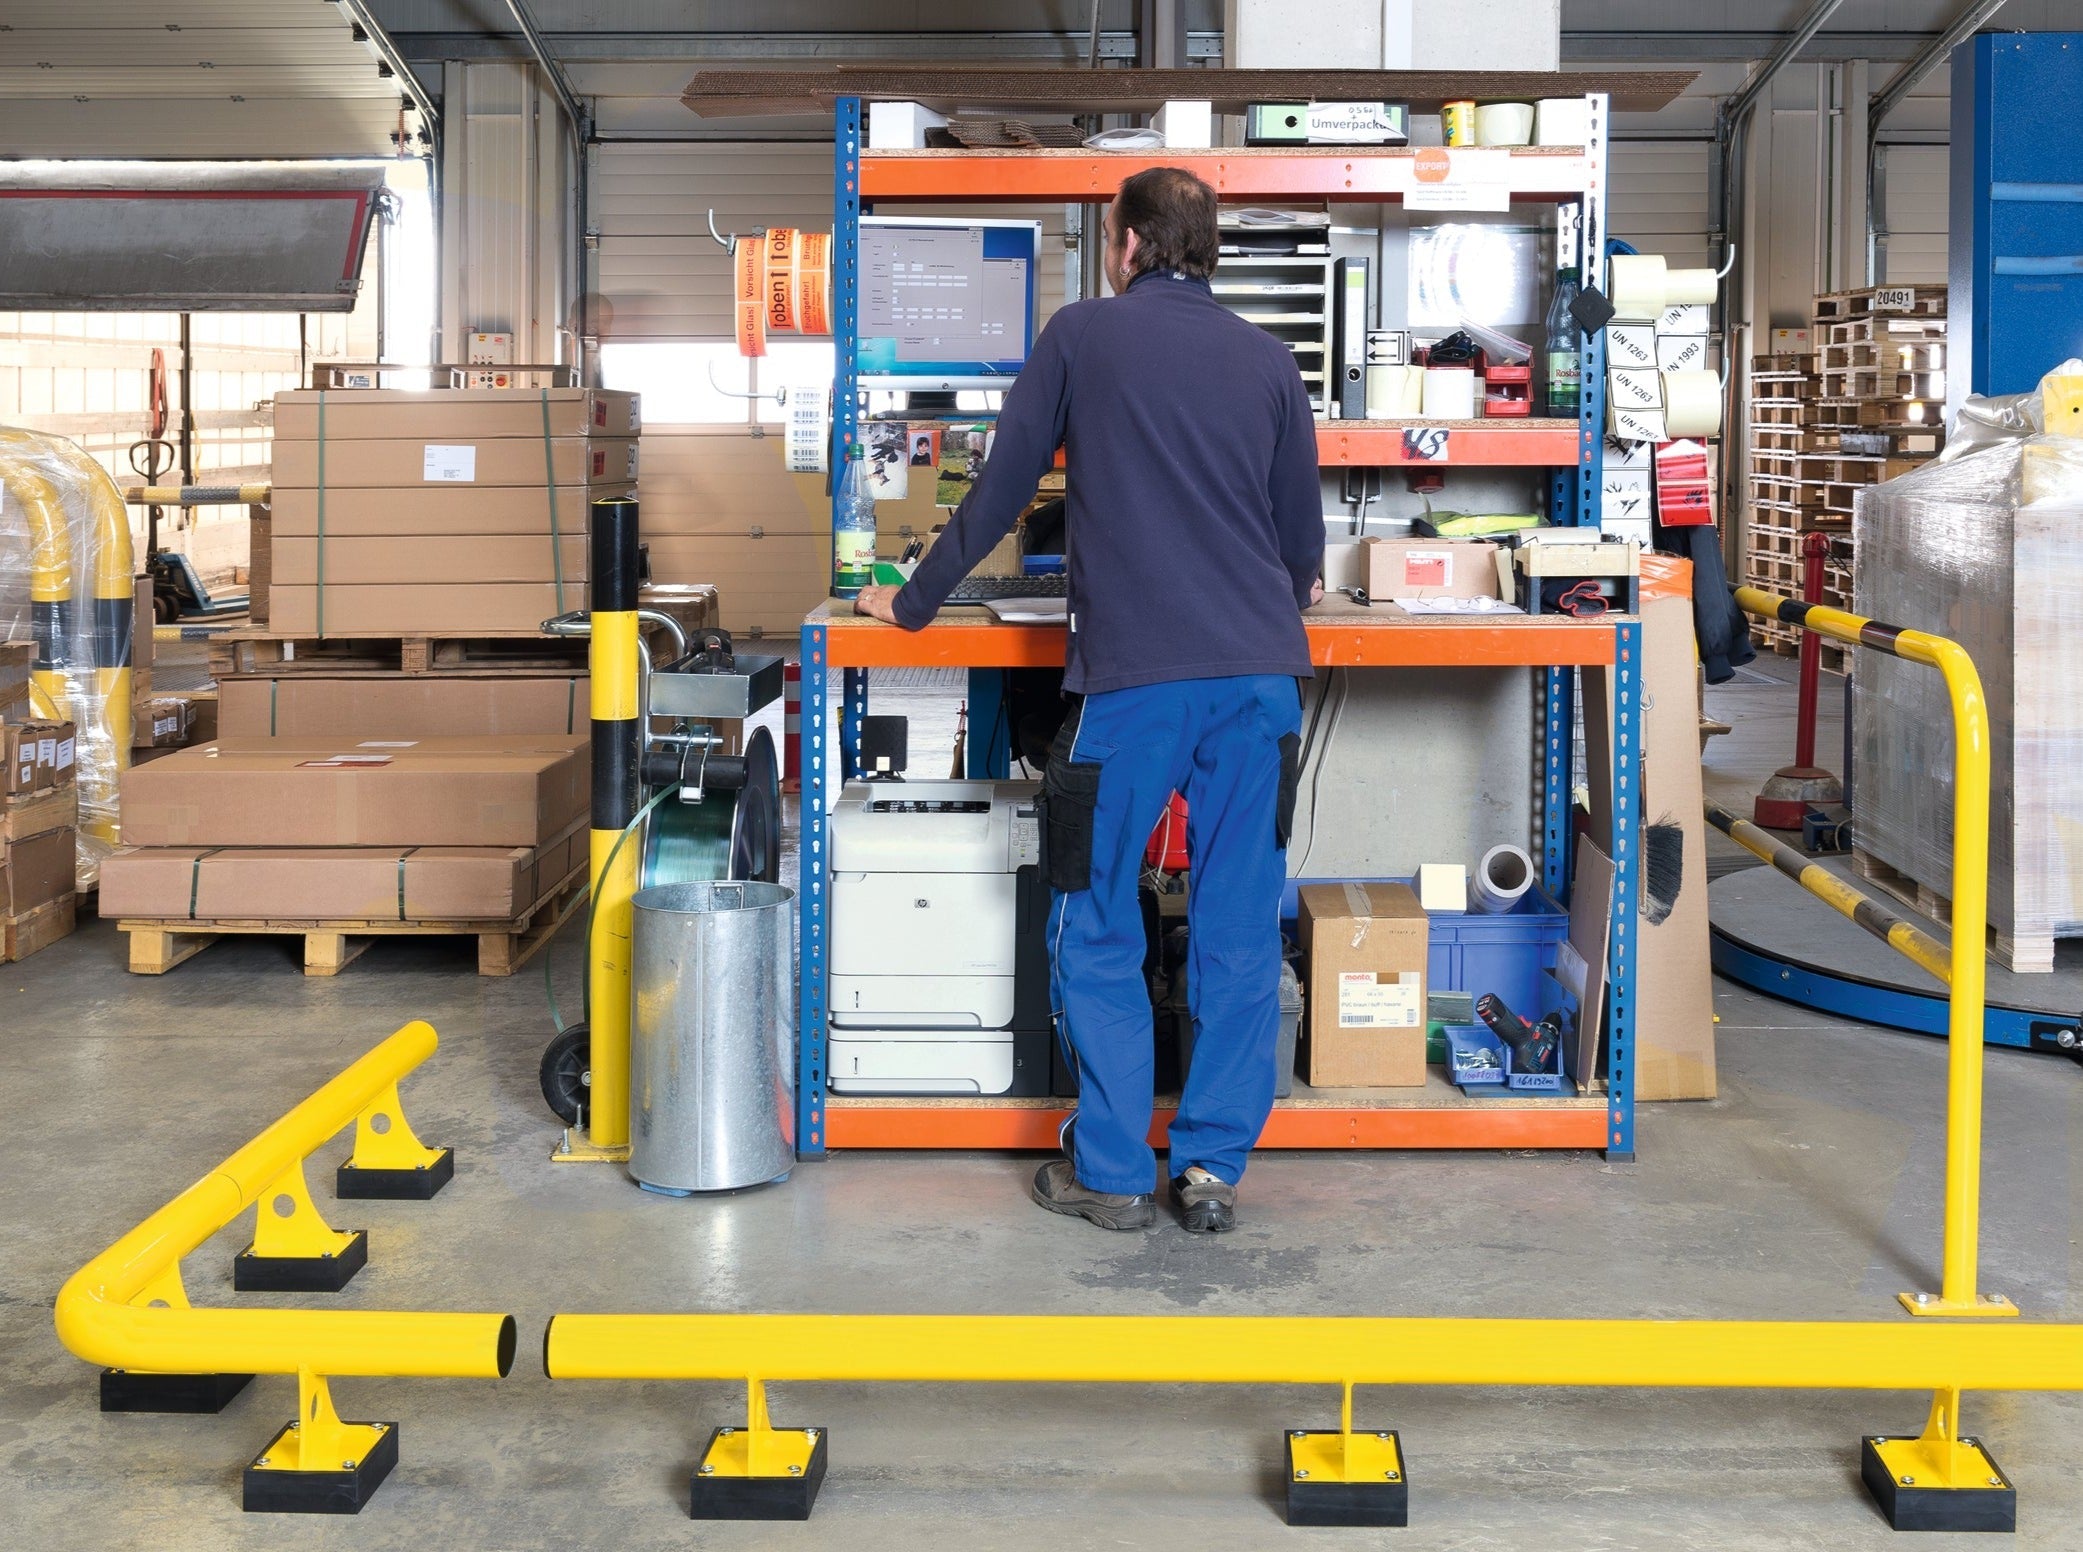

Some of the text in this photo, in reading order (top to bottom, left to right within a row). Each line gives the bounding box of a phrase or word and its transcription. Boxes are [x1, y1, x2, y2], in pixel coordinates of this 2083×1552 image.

[1415, 162, 1447, 171] EXPORT
[746, 259, 754, 298] Vorsicht
[771, 281, 786, 322] oben
[1877, 291, 1909, 305] 20491
[746, 306, 755, 331] Glas!
[1665, 310, 1682, 326] UN
[1612, 330, 1649, 361] UN 1263
[1678, 342, 1699, 363] 1993
[1616, 373, 1653, 403] UN 1263
[1620, 414, 1636, 428] UN
[1016, 1059, 1023, 1067] 3
